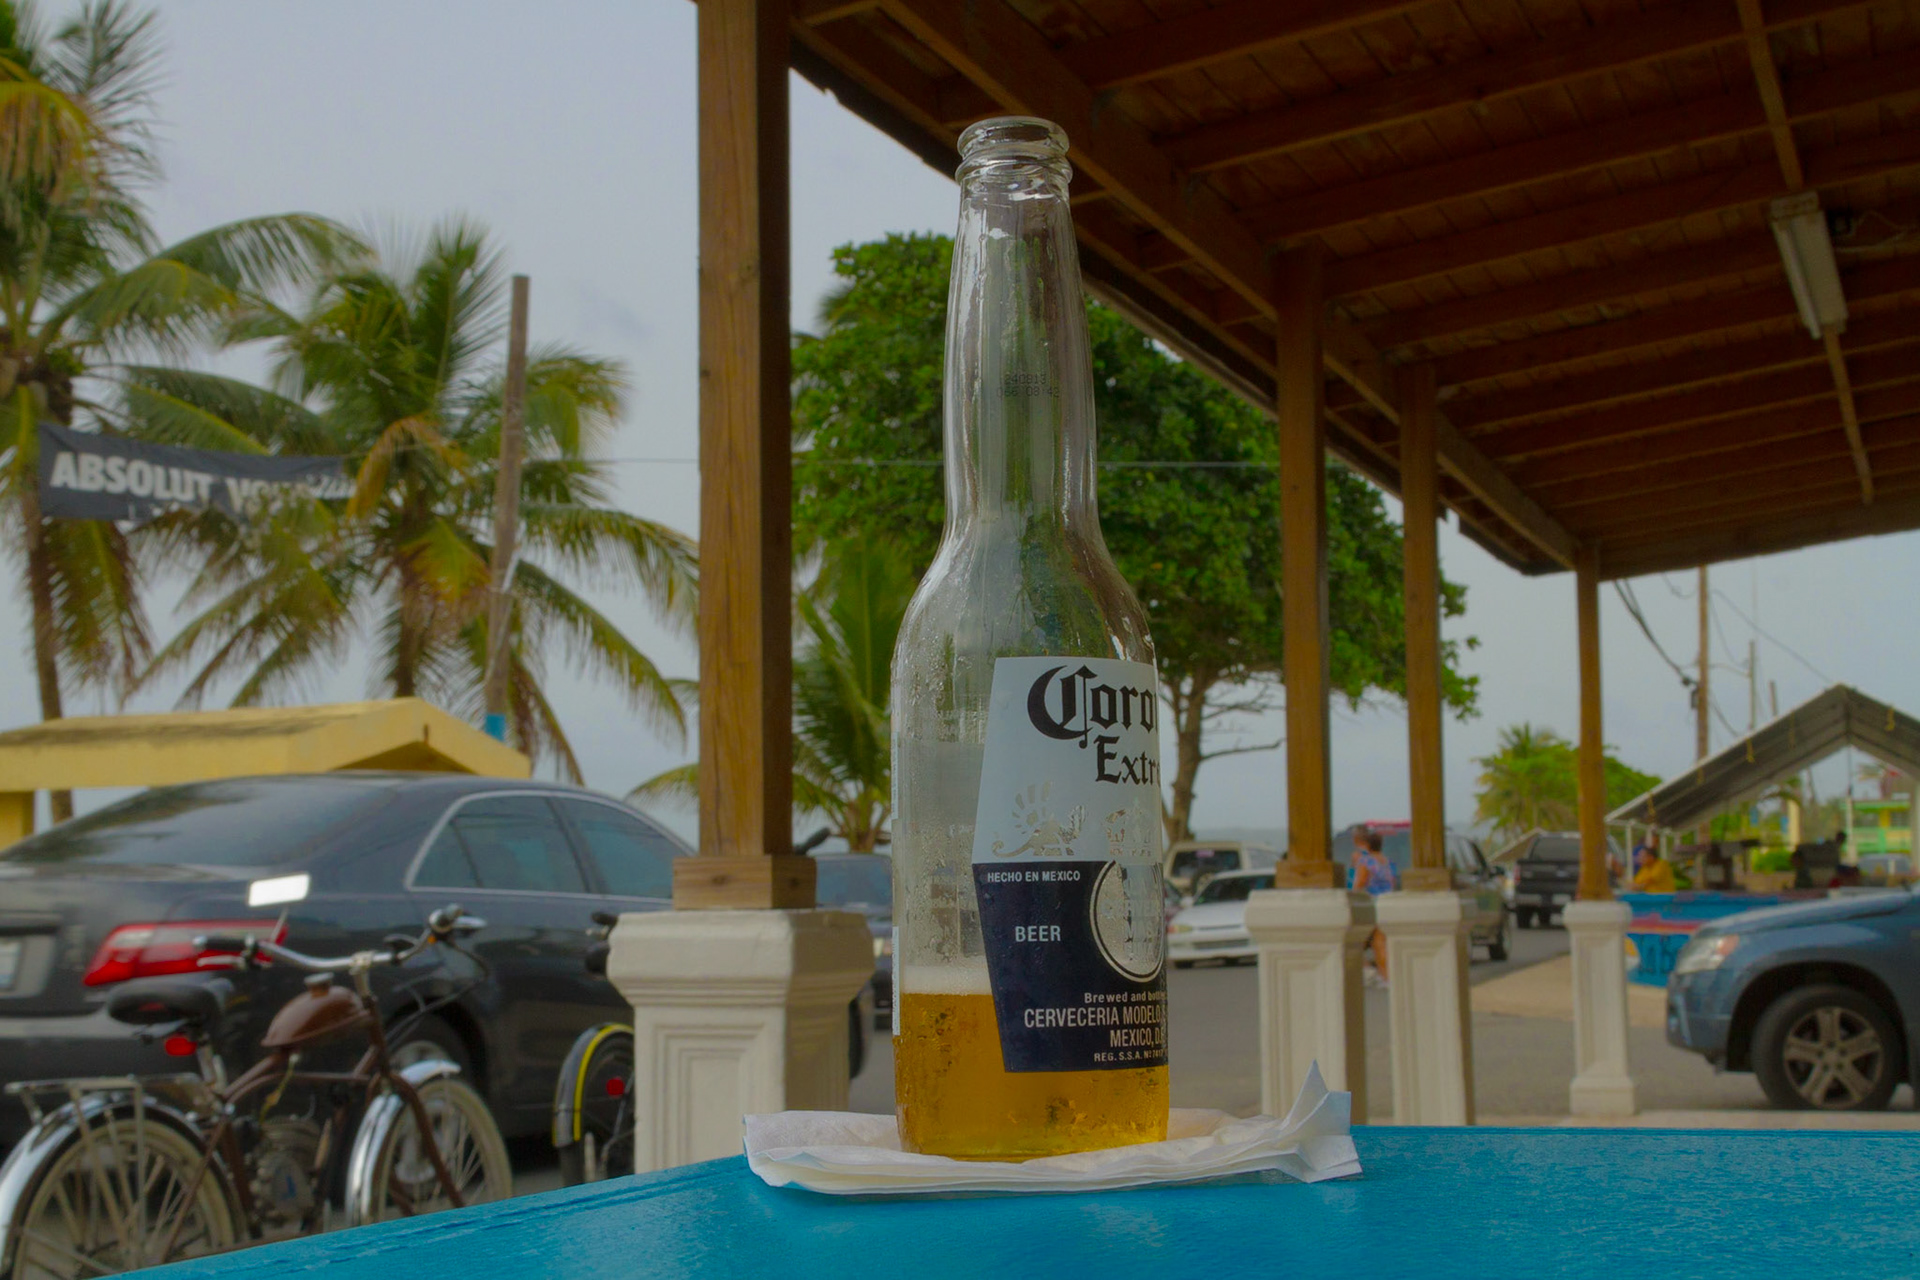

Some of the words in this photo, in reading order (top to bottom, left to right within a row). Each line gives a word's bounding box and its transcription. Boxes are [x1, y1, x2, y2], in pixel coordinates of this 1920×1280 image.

[49, 450, 213, 501] ABSOLUT
[1093, 735, 1160, 787] Extr
[987, 871, 1022, 883] HECHO
[1025, 871, 1039, 882] EN
[1042, 870, 1081, 882] MEXICO
[1014, 925, 1061, 942] BEER
[1084, 992, 1128, 1004] Brewed
[1131, 991, 1146, 1002] and
[1024, 1006, 1120, 1028] CERVECERIA
[1110, 1028, 1154, 1048] MEXICO,
[1094, 1052, 1117, 1062] REG.
[1118, 1051, 1142, 1060] S.S.A.
